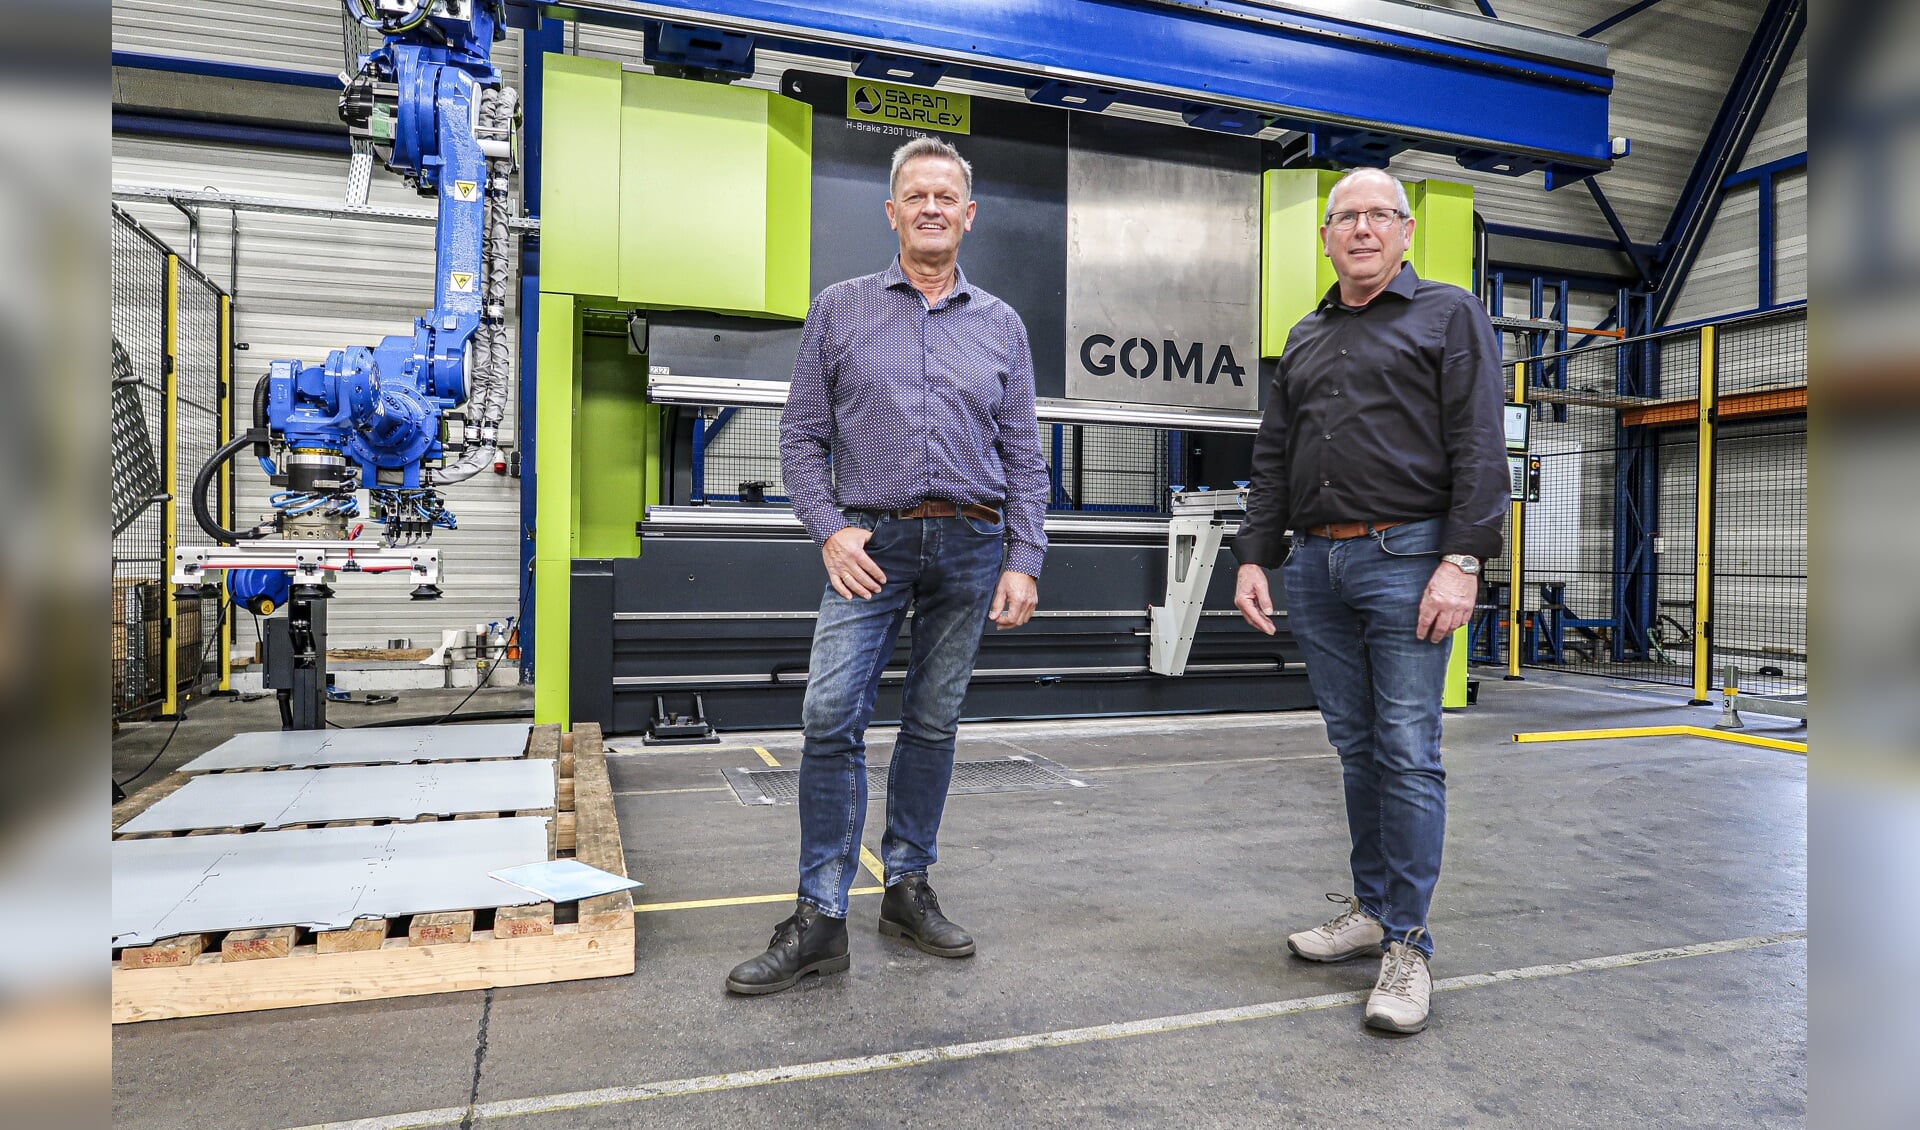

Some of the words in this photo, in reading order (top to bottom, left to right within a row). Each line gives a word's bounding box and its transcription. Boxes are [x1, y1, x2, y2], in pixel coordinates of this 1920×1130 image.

[846, 121, 881, 134] H-Brake
[882, 125, 904, 136] 230T
[905, 129, 927, 139] Ultra
[1080, 333, 1246, 387] GOMA
[1724, 699, 1730, 708] 3
